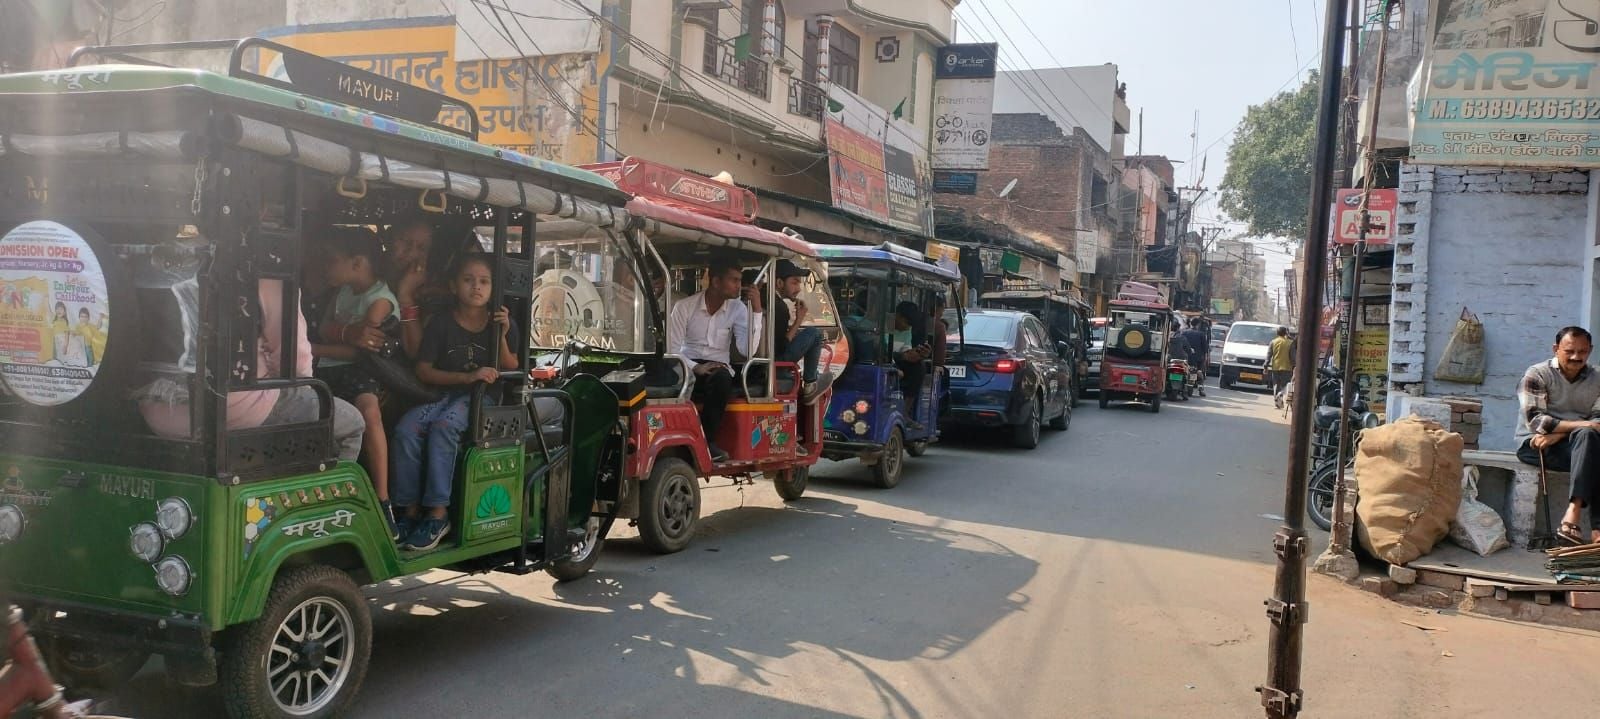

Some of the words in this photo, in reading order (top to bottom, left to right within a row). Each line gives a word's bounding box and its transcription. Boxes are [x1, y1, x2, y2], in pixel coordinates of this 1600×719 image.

[338, 75, 400, 101] MAYURI
[1462, 98, 1600, 121] 6389436532
[47, 246, 79, 259] OPEN
[99, 474, 155, 500] MAYURI
[281, 509, 356, 537] मयूरी
[481, 519, 508, 529] MAYURI
